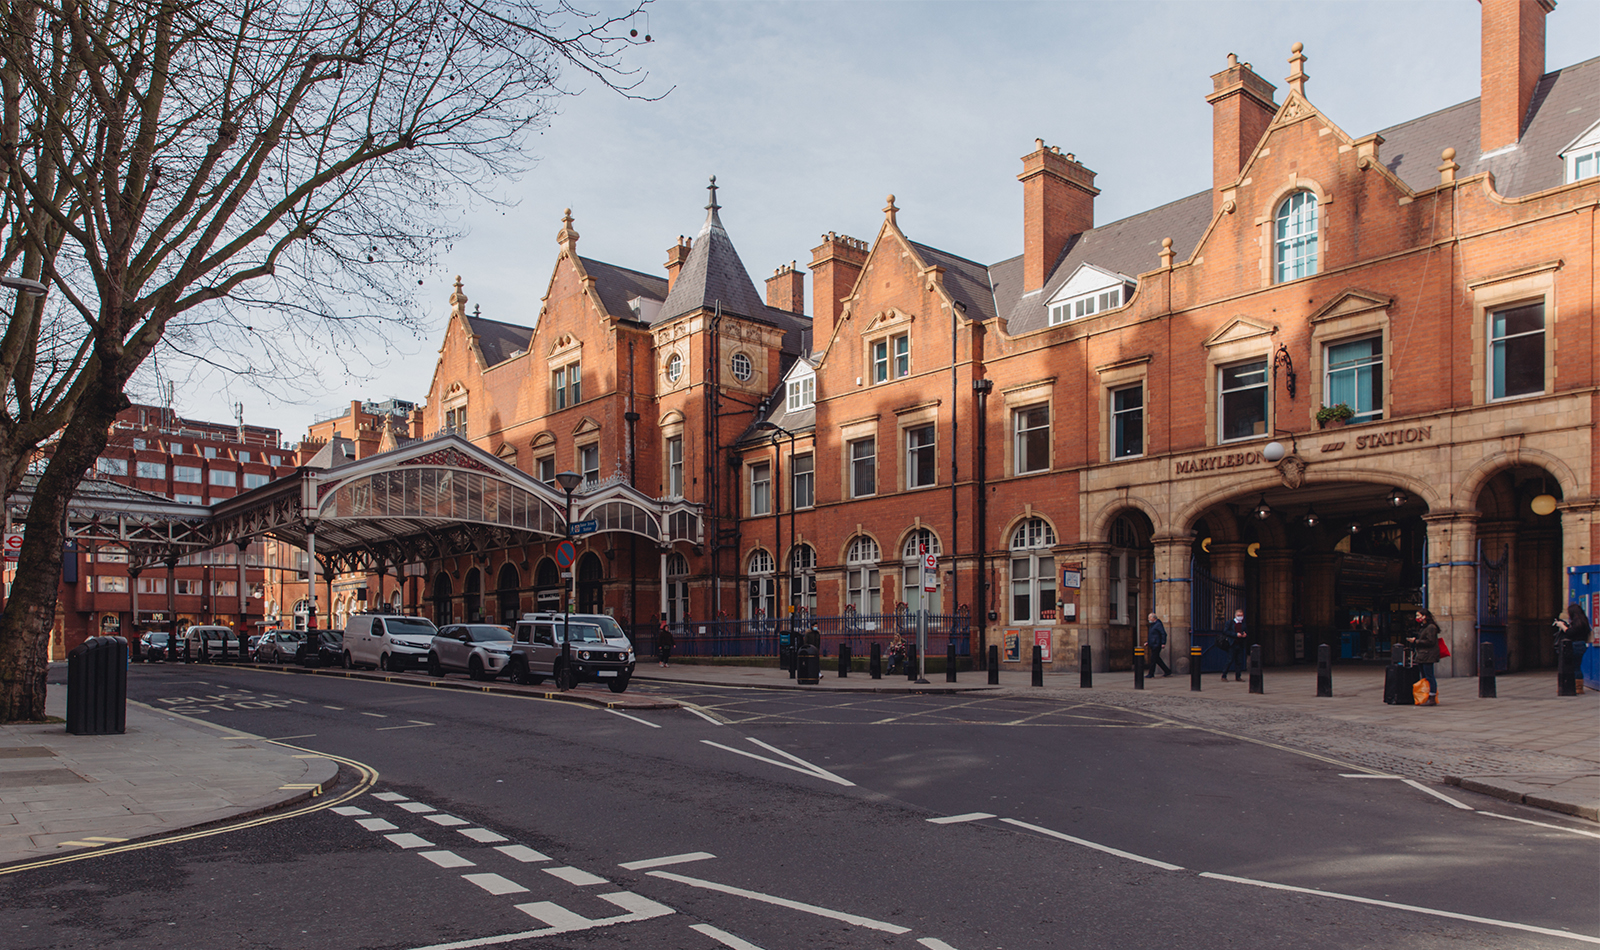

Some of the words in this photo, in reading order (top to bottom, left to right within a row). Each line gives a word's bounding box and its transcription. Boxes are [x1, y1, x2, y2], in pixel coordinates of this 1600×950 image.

[1176, 451, 1268, 474] MARYLEBON
[1355, 426, 1433, 450] STATION
[157, 693, 256, 705] BUS
[168, 699, 293, 715] STOP
